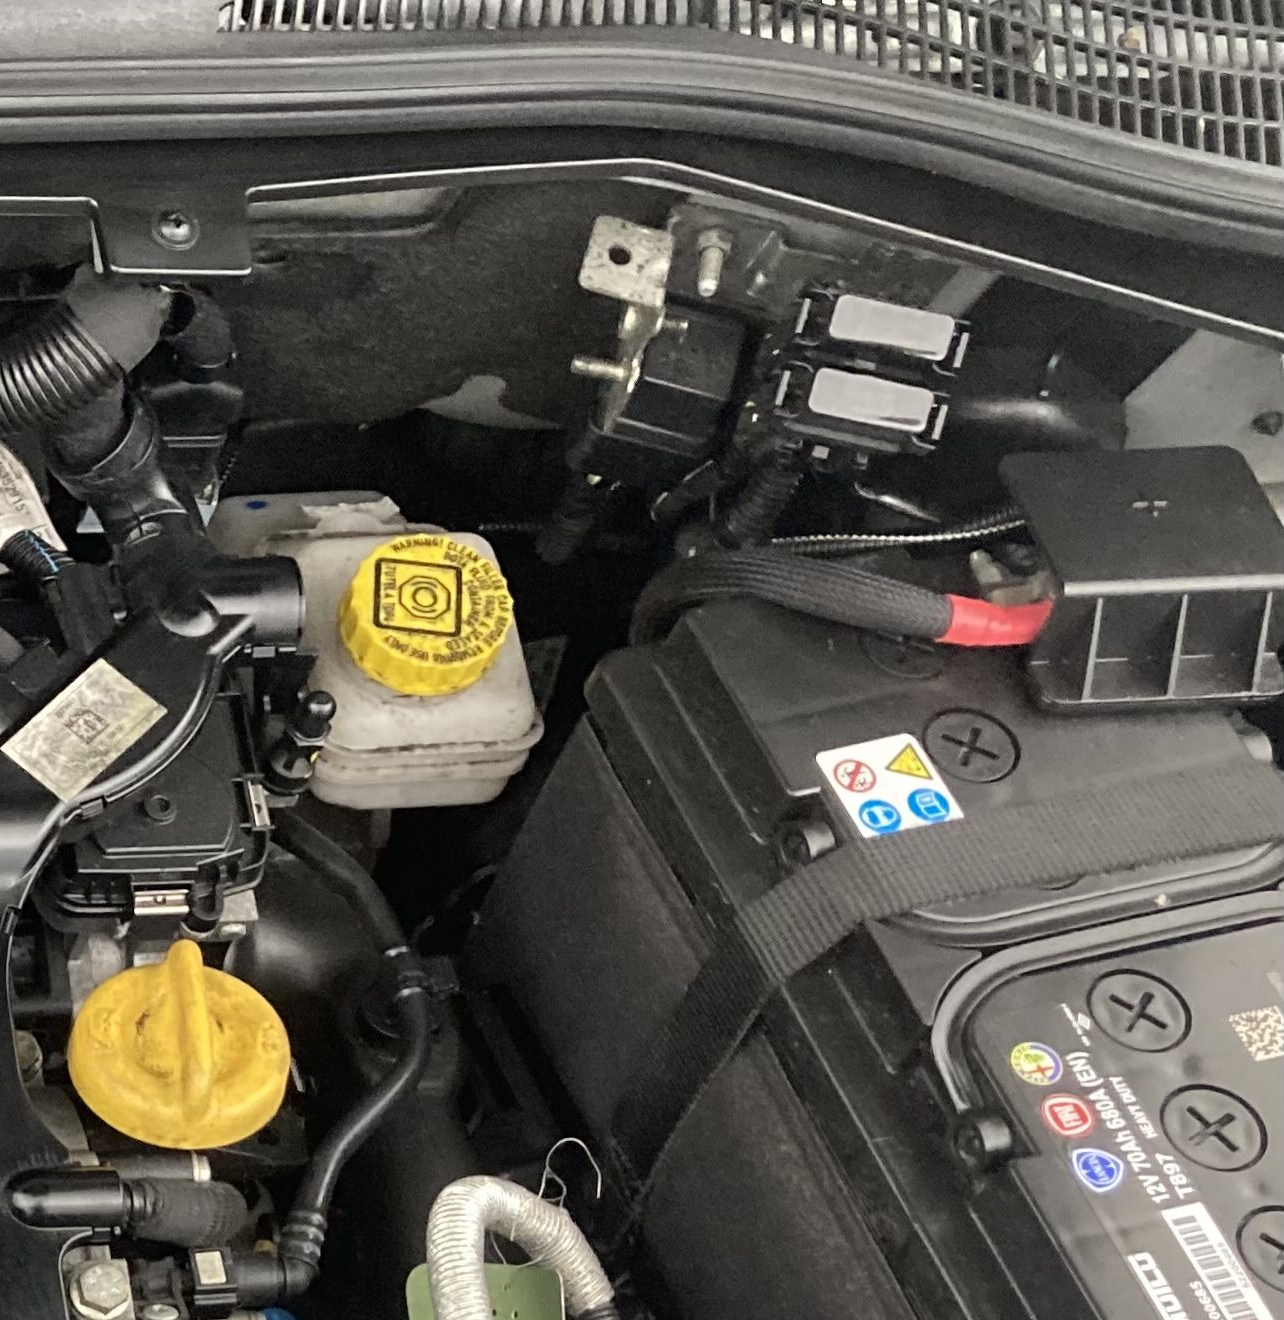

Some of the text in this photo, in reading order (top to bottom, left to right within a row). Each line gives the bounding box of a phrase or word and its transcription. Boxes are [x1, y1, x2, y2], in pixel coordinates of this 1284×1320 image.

[447, 541, 480, 562] CLEAN
[1066, 1051, 1104, 1087] (EN)
[1089, 1088, 1127, 1130] 680A
[1109, 1076, 1158, 1140] HEAVY DUTY
[1116, 1130, 1156, 1173] 70Ah
[1138, 1174, 1170, 1204] 12V
[1155, 1153, 1197, 1199] T897
